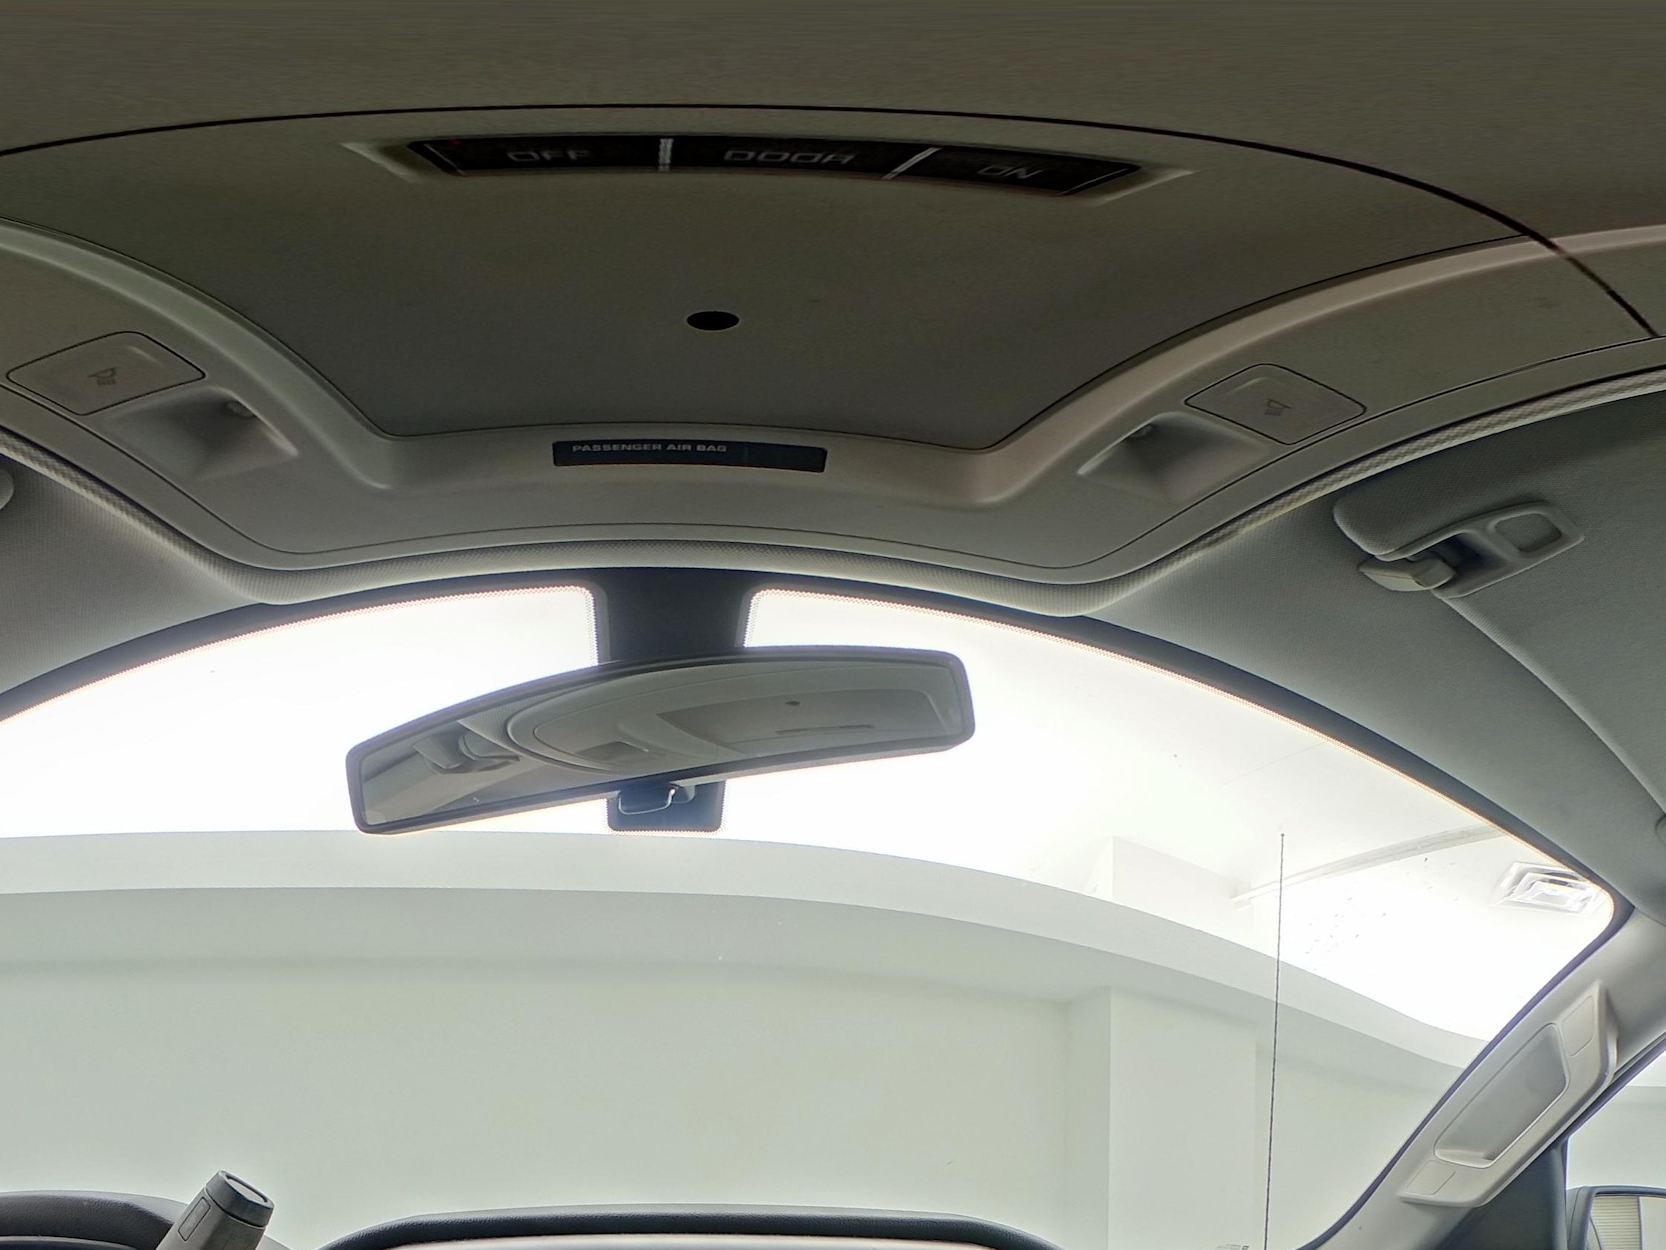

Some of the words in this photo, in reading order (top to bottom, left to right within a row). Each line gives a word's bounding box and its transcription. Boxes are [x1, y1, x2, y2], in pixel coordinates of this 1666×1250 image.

[506, 148, 590, 163] OFF
[723, 148, 855, 165] DOOR
[977, 164, 1044, 181] ON
[572, 443, 663, 453] PASSENGER
[666, 443, 692, 452] AIR
[696, 444, 728, 453] BAG
